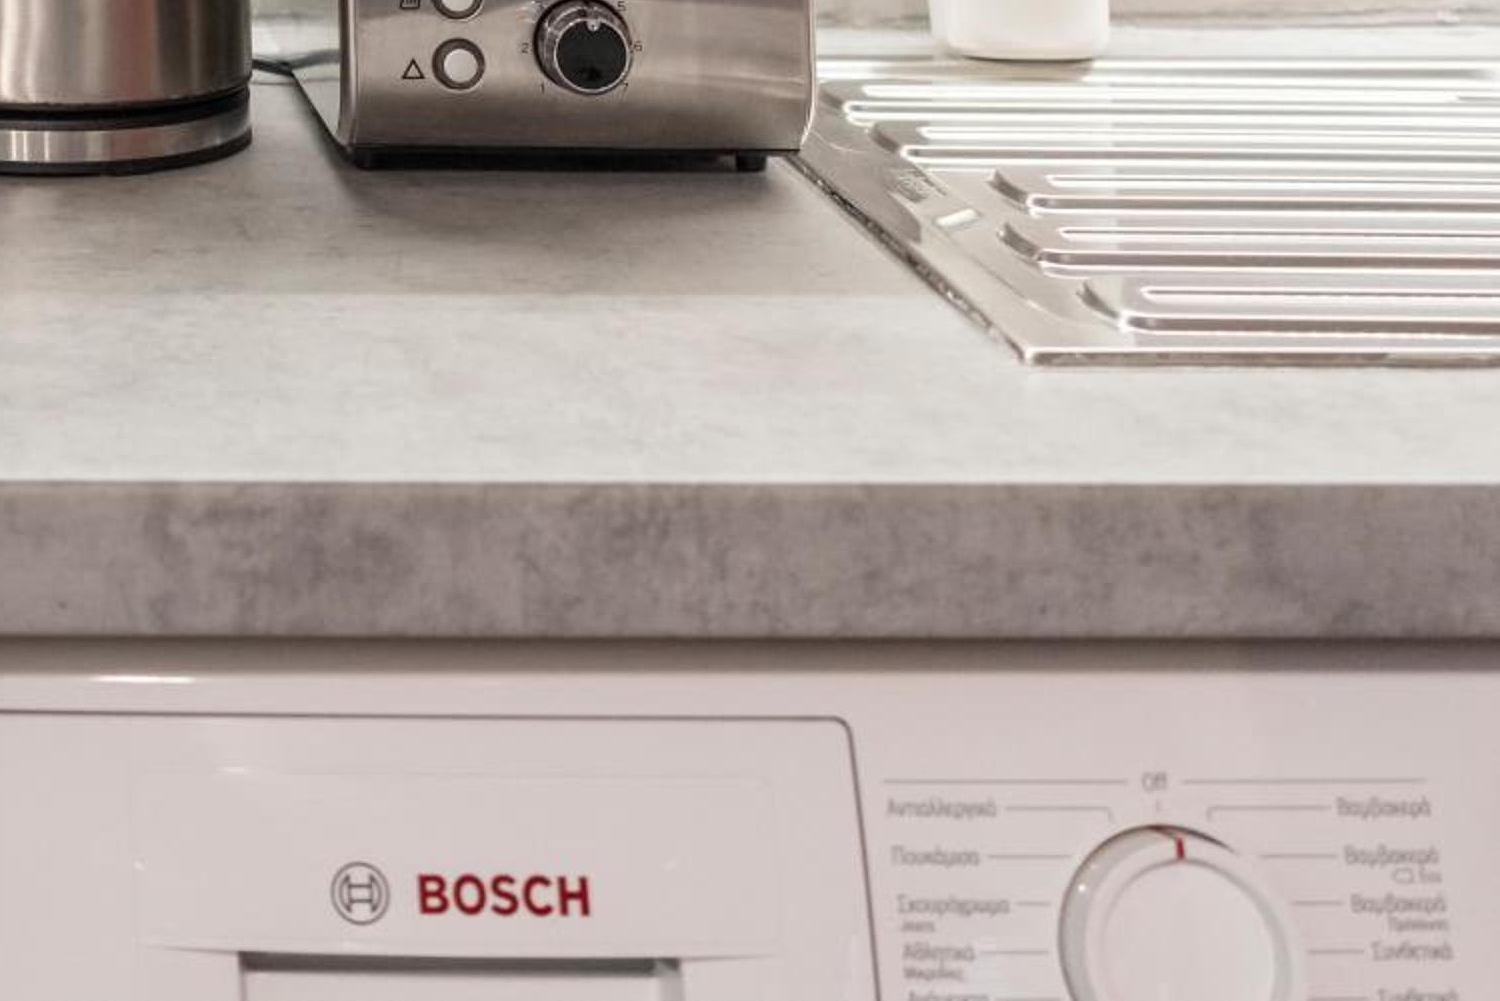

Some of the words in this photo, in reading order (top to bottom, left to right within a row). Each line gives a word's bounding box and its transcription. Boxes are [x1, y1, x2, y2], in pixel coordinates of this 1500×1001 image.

[1141, 771, 1168, 793] Off
[1336, 796, 1431, 820] Βαμβακερά
[891, 843, 980, 866] Πουκάμισα
[1343, 844, 1439, 869] Βαμβακερά
[417, 872, 591, 917] BOSCH
[1349, 892, 1446, 915] Βαμβακερά
[1371, 938, 1454, 960] Συνθετικά
